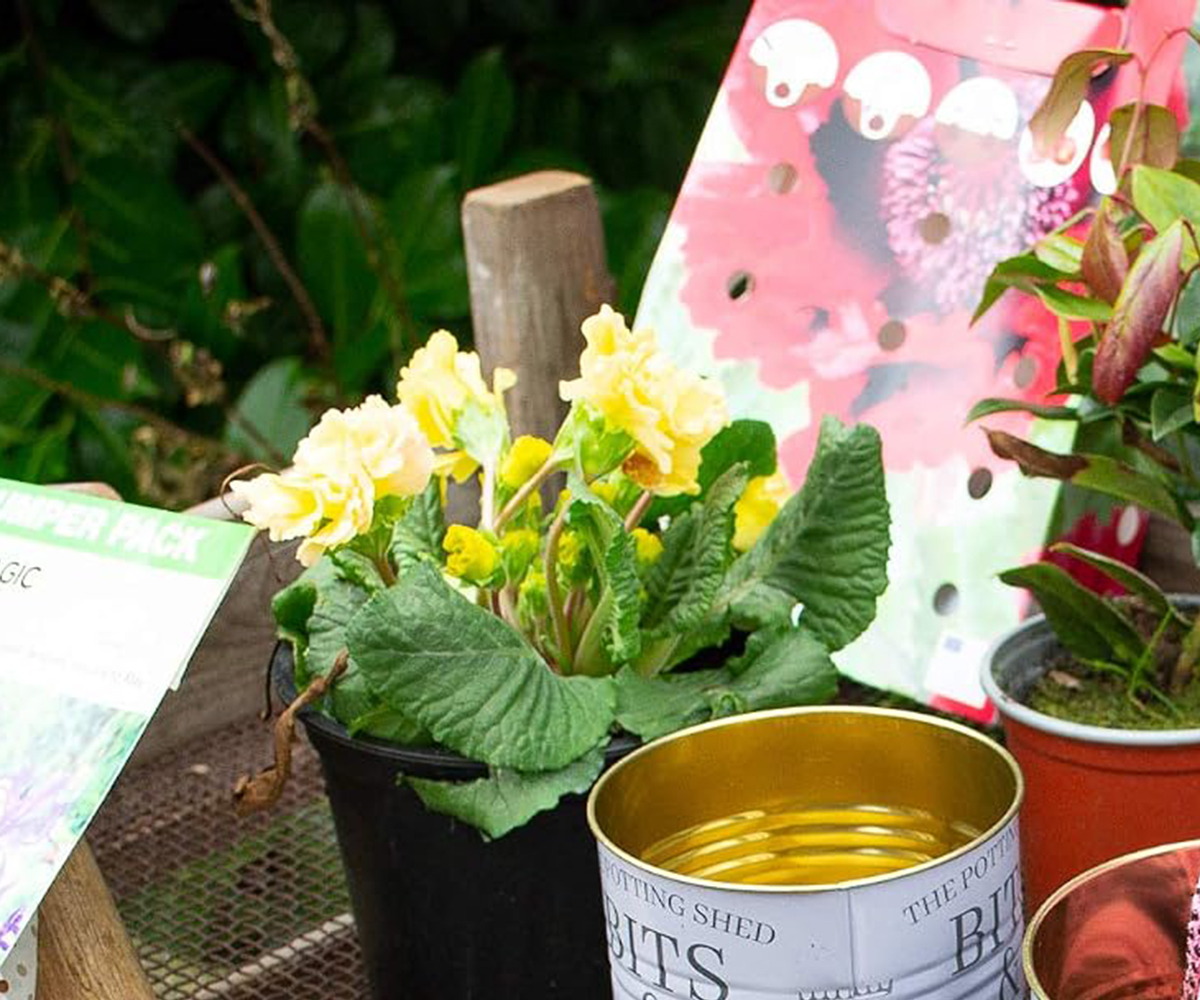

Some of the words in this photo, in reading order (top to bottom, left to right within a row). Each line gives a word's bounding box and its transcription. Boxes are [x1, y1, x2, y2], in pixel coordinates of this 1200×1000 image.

[0, 488, 109, 542] MPER
[105, 510, 209, 564] PACK
[0, 561, 42, 589] GIC
[693, 903, 777, 946] SHED
[902, 879, 958, 925] THE
[950, 865, 1019, 976] BIT
